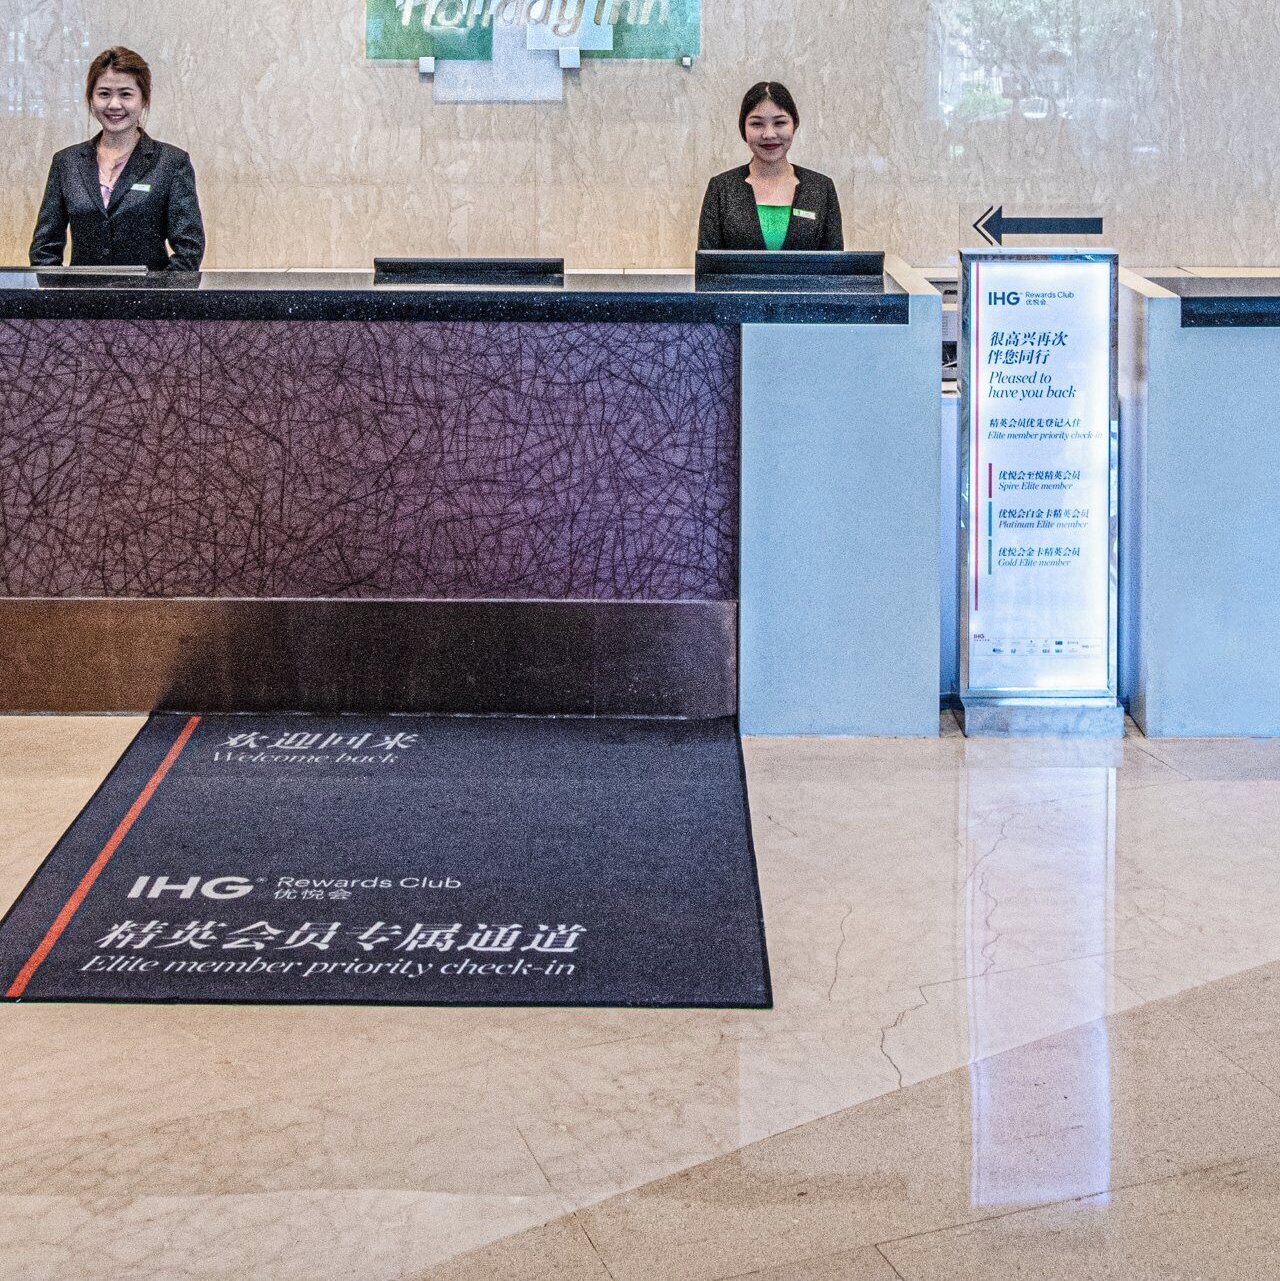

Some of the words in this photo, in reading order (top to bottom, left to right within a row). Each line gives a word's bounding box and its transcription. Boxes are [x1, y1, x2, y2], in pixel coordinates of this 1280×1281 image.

[988, 291, 1020, 305] IHG
[991, 331, 1068, 346] 很高兴再次
[988, 349, 1050, 364] 伴您同行
[989, 371, 1038, 384] Pleased
[1040, 372, 1052, 383] to
[988, 385, 1019, 398] have
[1019, 388, 1044, 401] you
[1046, 385, 1076, 398] back
[989, 418, 1081, 428] 精英会员优先登记入住
[987, 431, 1006, 439] Elite
[1007, 431, 1039, 439] member
[1039, 431, 1070, 441] priority
[998, 470, 1080, 480] 优悦会至悦精英会员
[998, 481, 1019, 491] Spire
[1021, 481, 1040, 490] Elite
[1041, 482, 1073, 490] member
[998, 508, 1089, 518] 优悦会白金卡精英会员
[998, 520, 1035, 528] Platinum
[1036, 520, 1055, 528] Elite
[1056, 520, 1088, 528] member
[998, 547, 1080, 557] 优悦会金卡精英会员
[998, 559, 1017, 567] Gold
[1019, 559, 1038, 567] Elite
[1038, 559, 1071, 567] member
[218, 731, 418, 749] 欢迎回来
[213, 751, 329, 763] Welcome
[336, 752, 399, 763] back
[126, 876, 254, 900] IHG
[278, 876, 393, 889] Rewards
[401, 876, 461, 889] Club
[274, 889, 352, 901] 优悦会
[95, 921, 587, 952] 精英会员专属通道
[81, 954, 160, 973] Elite
[164, 956, 303, 974] member
[302, 958, 434, 978] priority
[440, 958, 576, 976] check-in
